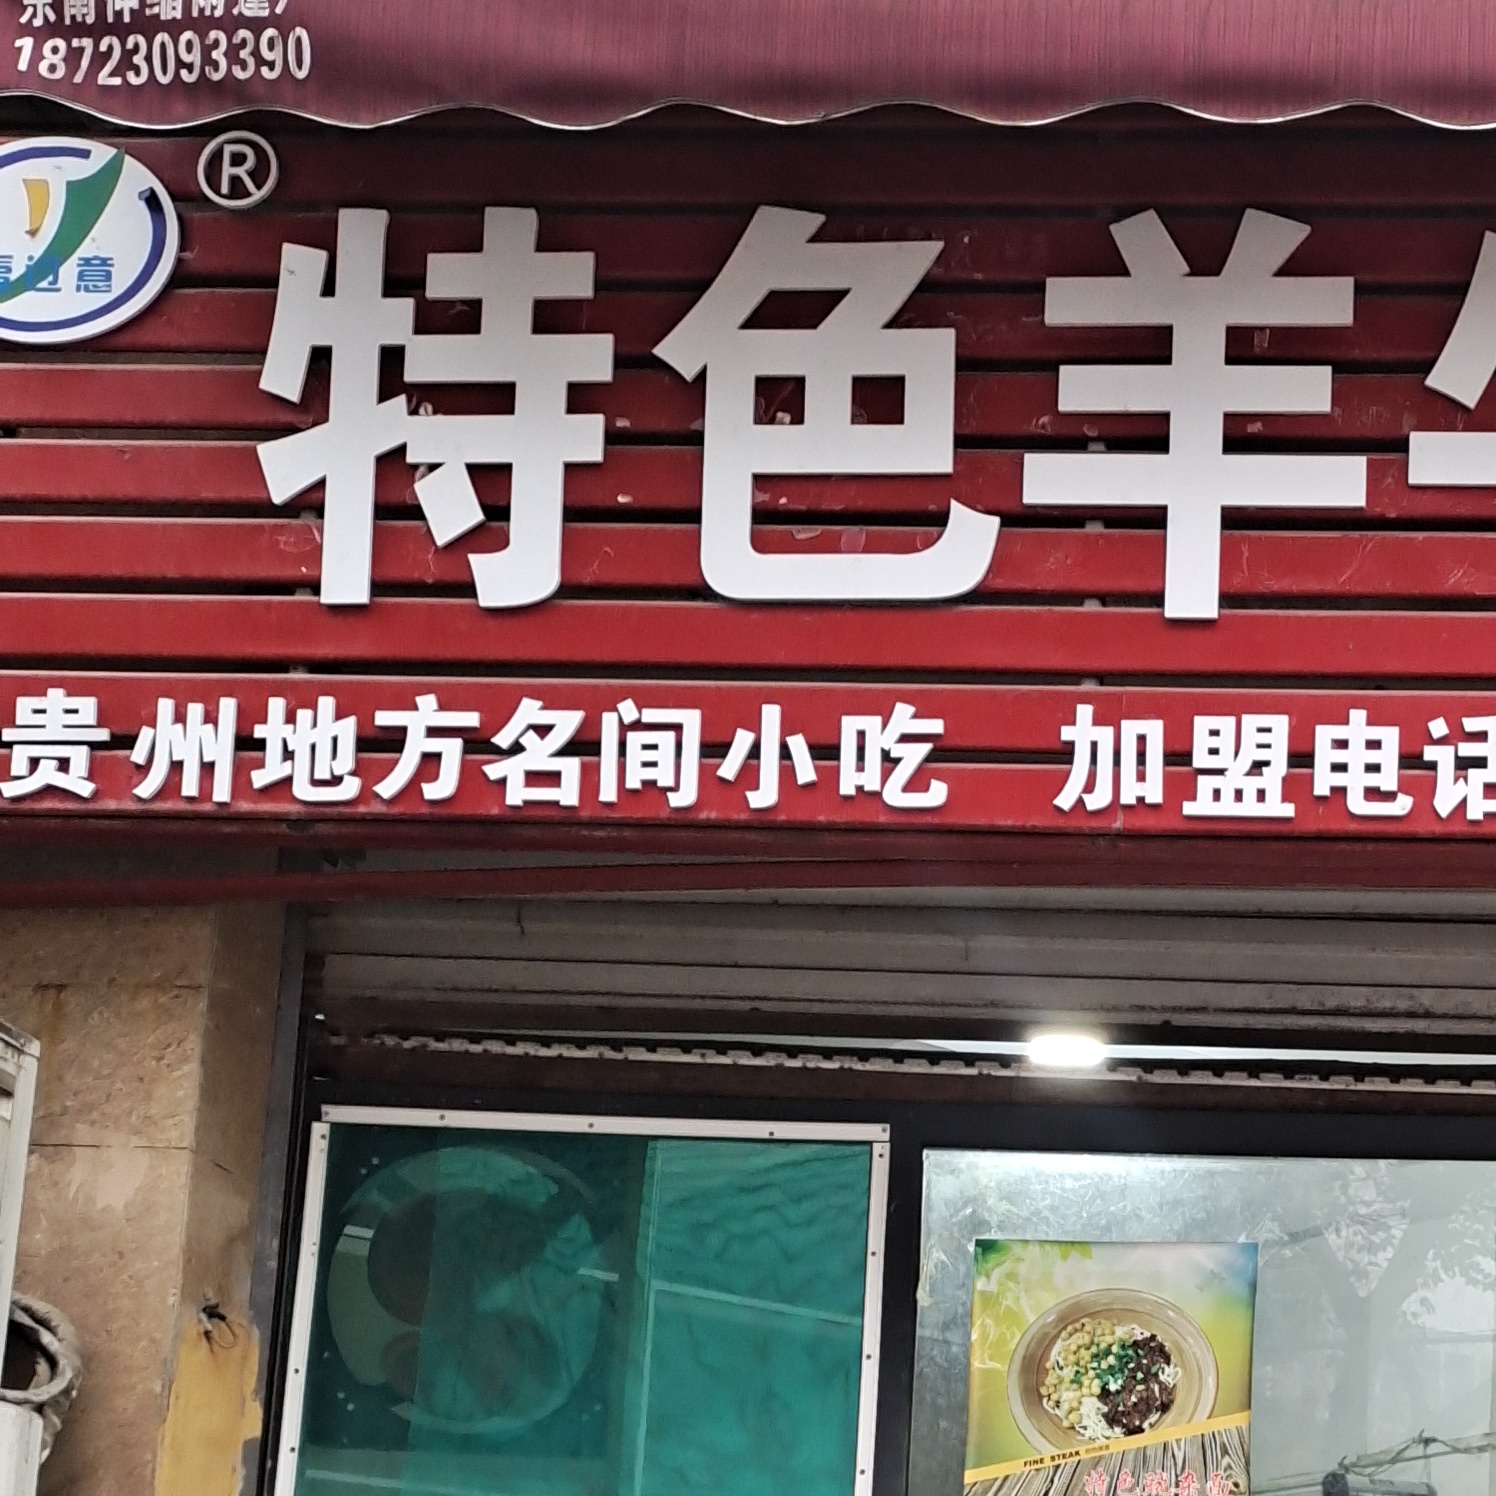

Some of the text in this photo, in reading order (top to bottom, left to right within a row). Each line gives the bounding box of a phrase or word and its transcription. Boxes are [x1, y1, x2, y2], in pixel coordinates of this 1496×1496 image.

[13, 26, 311, 86] 18723093390
[0, 688, 949, 809] 贵州地方名间小吃
[1023, 1449, 1081, 1468] FINE STEAK
